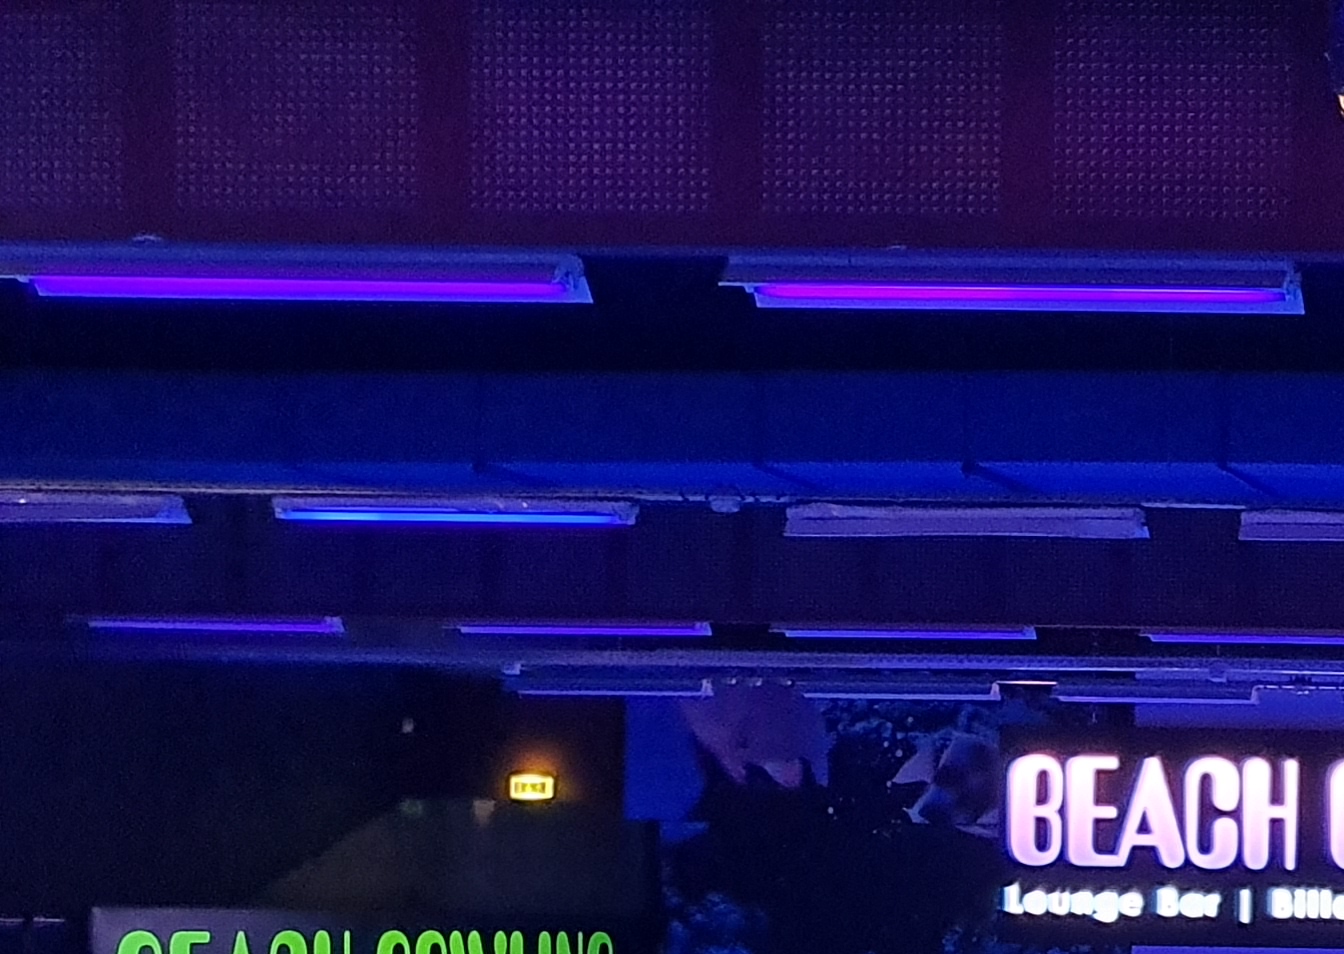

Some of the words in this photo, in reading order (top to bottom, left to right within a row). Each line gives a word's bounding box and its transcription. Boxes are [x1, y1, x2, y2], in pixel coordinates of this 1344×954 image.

[1007, 753, 1300, 871] BEACH
[1002, 882, 1144, 923] Lounge
[1155, 885, 1222, 918] Bar
